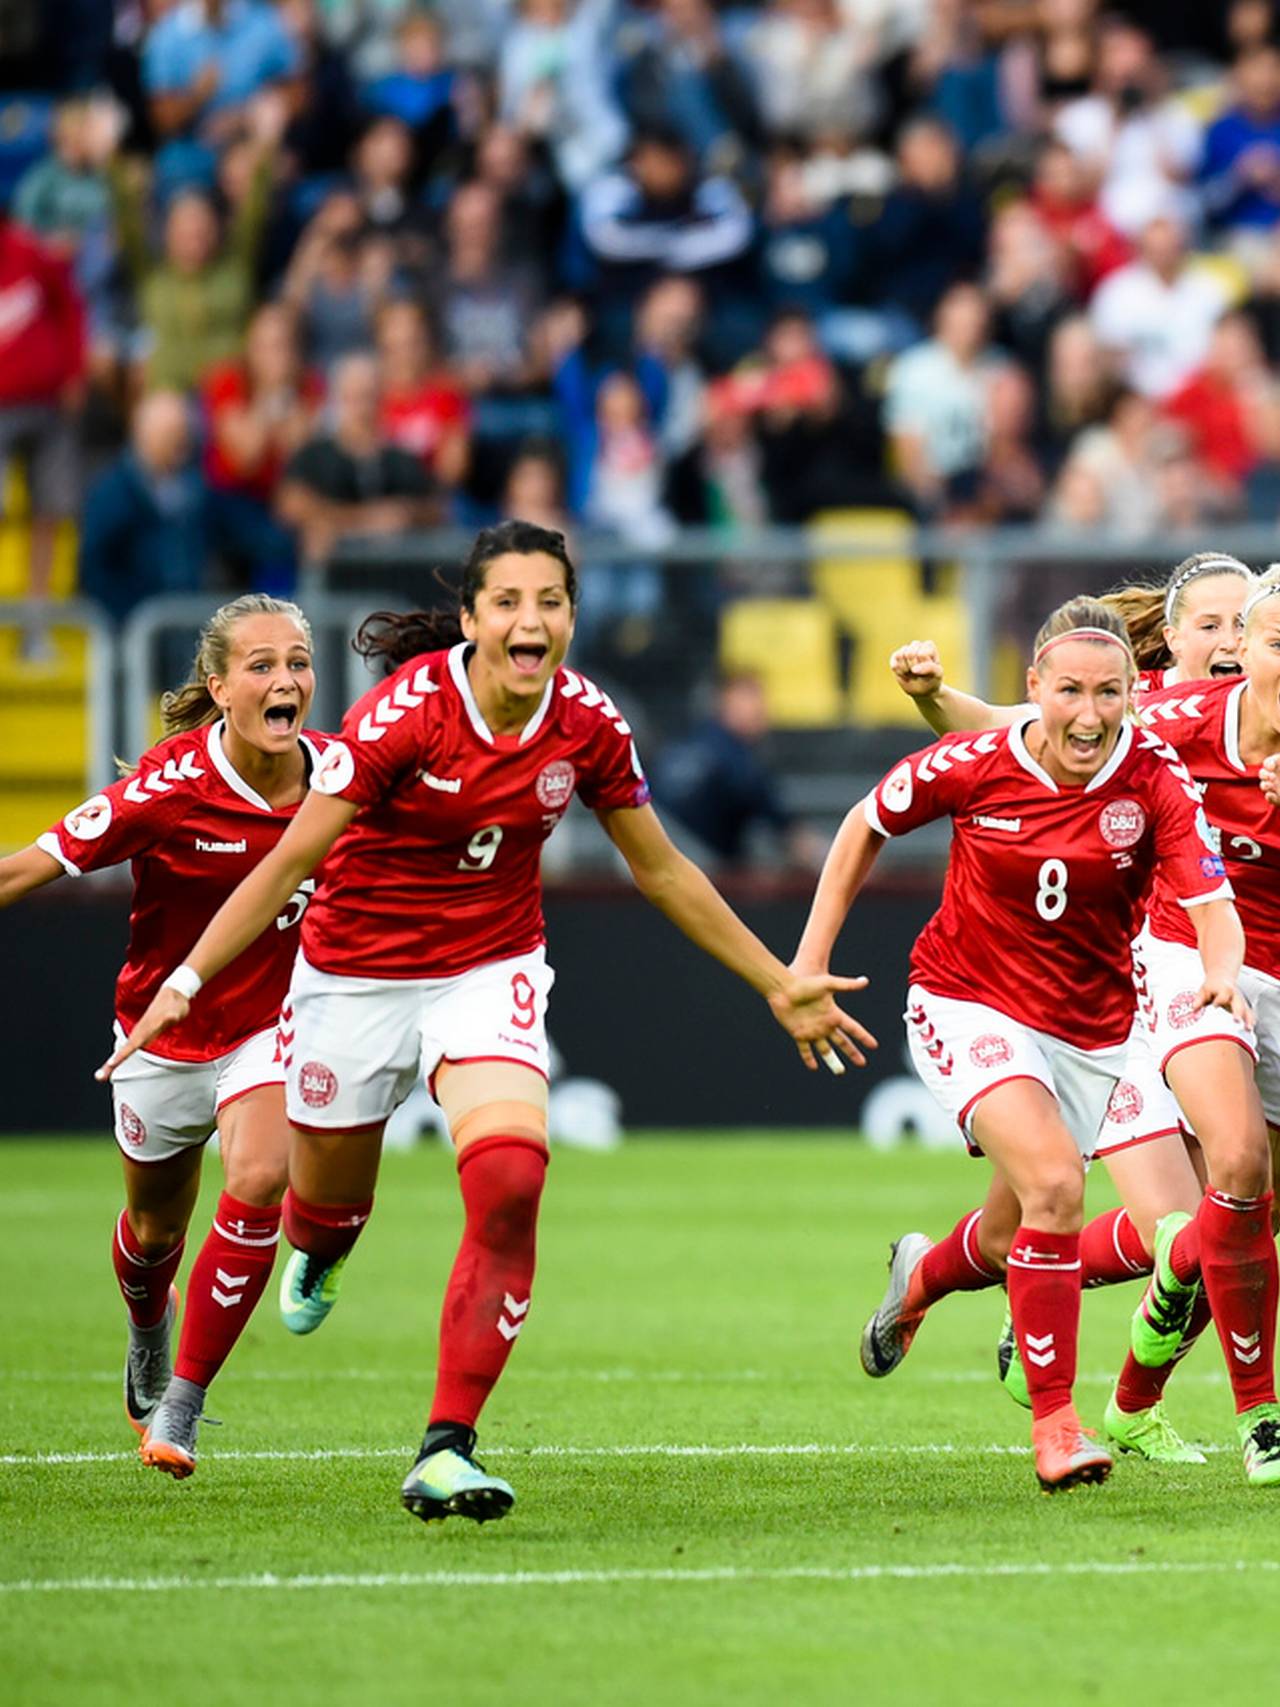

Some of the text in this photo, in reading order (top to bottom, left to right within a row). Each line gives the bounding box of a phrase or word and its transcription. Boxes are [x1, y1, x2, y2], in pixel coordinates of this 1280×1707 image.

[195, 838, 246, 853] hummel
[457, 824, 503, 871] 9
[1036, 858, 1068, 921] 8
[511, 972, 536, 1030] 9
